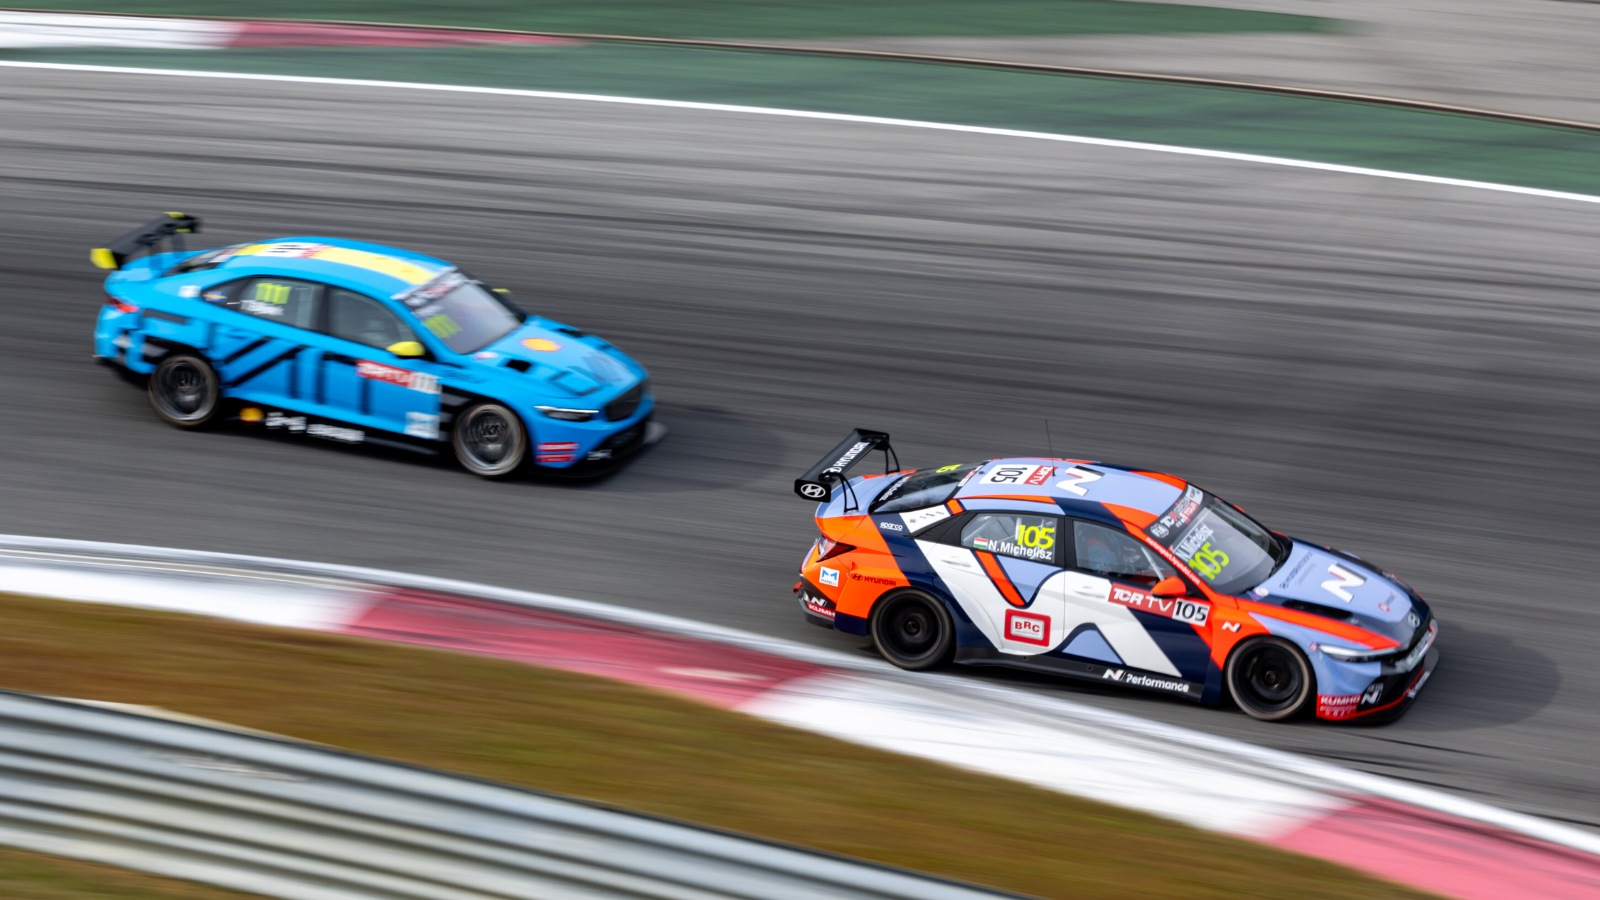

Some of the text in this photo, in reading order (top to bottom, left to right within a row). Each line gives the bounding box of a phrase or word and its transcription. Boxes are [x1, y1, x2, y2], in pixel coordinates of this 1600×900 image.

[990, 467, 1028, 483] 105
[880, 521, 903, 532] sparco
[1017, 524, 1055, 550] 105
[1188, 542, 1229, 581] 105
[864, 576, 896, 586] HYUNDAI
[1175, 601, 1209, 622] 105
[1014, 620, 1041, 633] BRC
[1126, 673, 1190, 693] Performance
[1320, 694, 1361, 706] KUMHO
